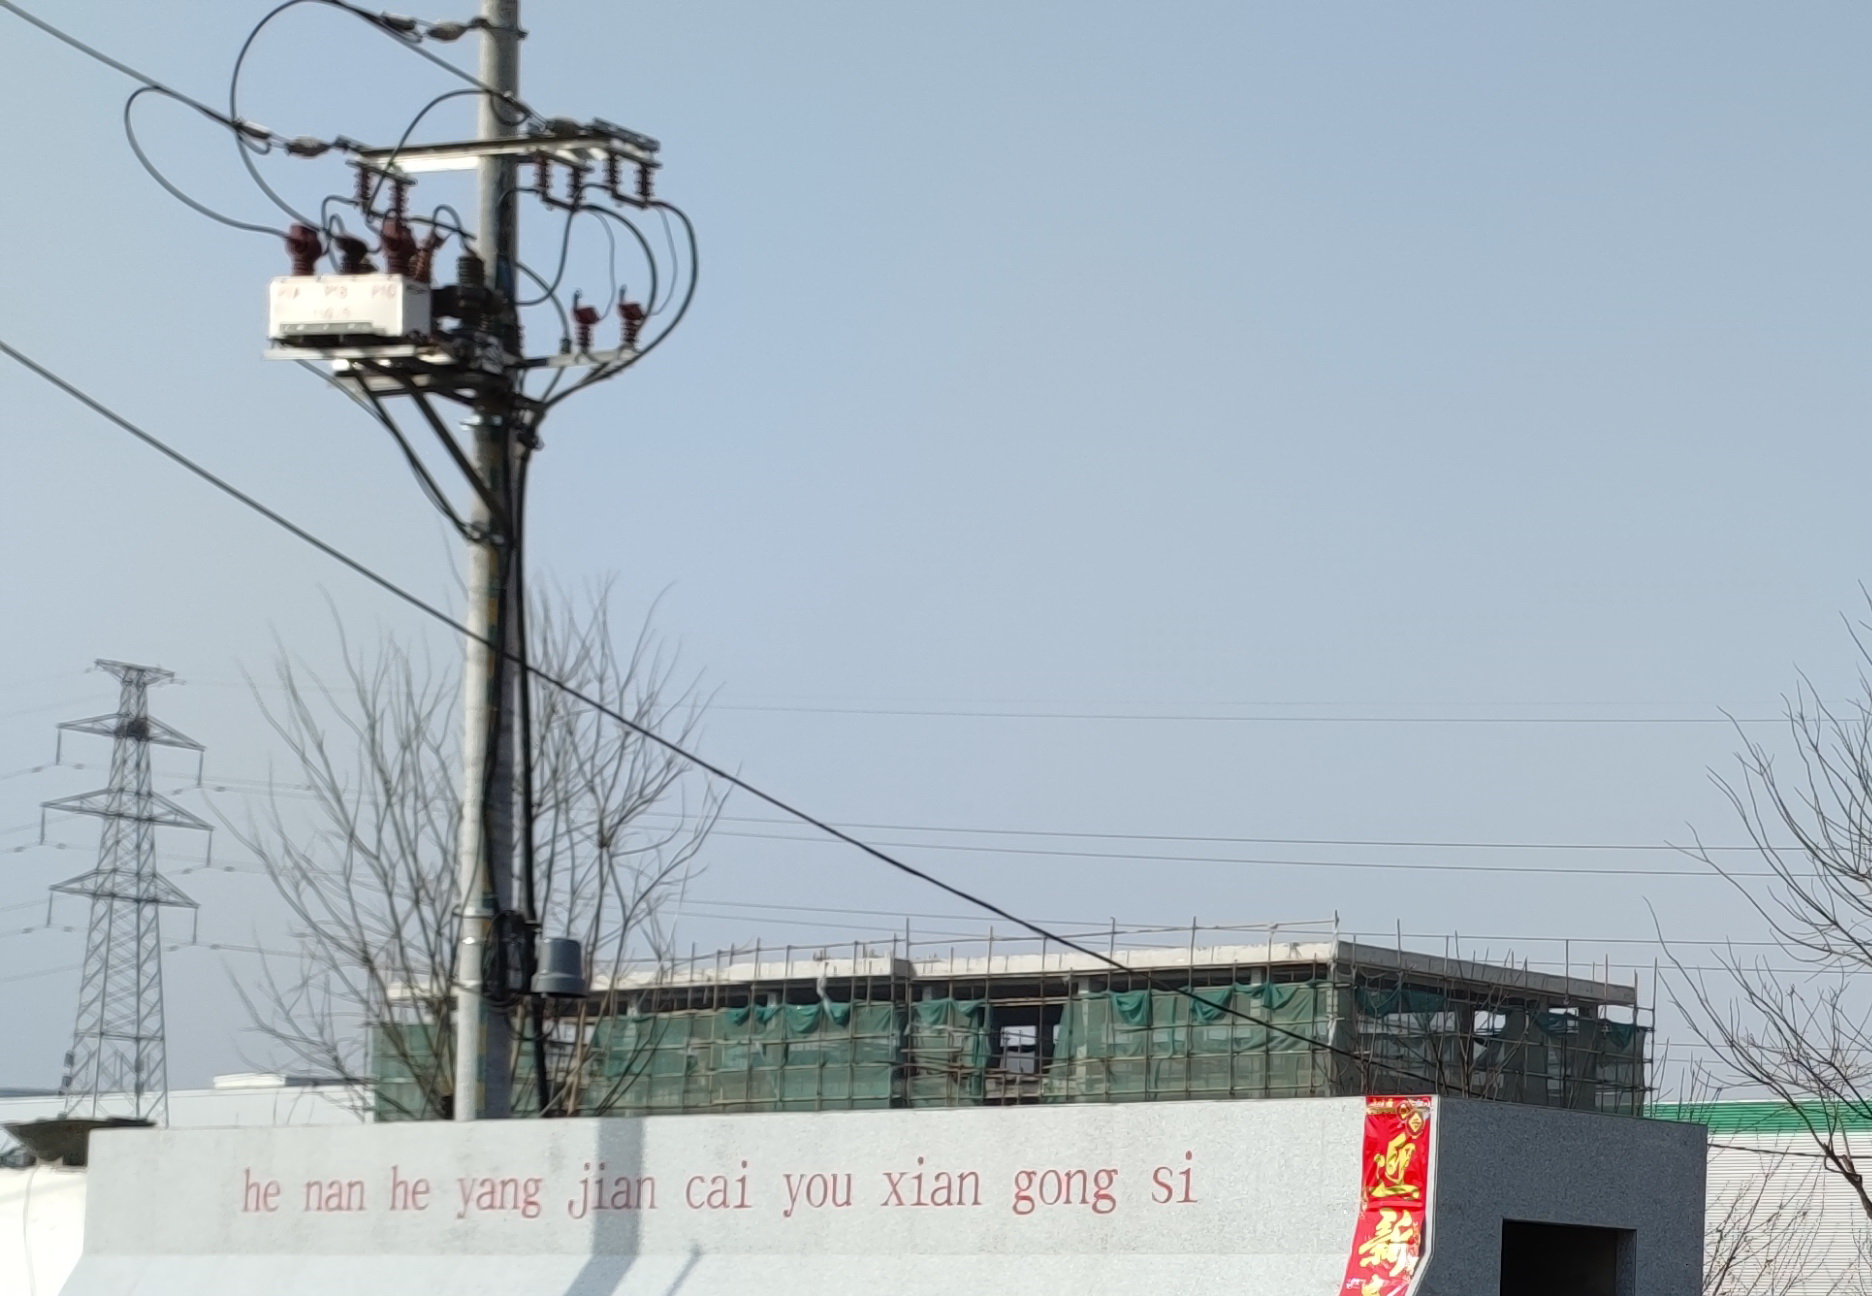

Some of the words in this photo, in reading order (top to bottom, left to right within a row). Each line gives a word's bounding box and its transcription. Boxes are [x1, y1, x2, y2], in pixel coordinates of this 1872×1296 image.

[241, 1167, 280, 1213] he
[303, 1176, 366, 1212] nan
[388, 1164, 430, 1212] he
[455, 1173, 543, 1220] yang
[567, 1161, 659, 1220] jian
[685, 1159, 753, 1210] cai
[782, 1173, 854, 1218] you
[880, 1156, 982, 1208] xian
[1011, 1165, 1120, 1217] gong
[1150, 1149, 1200, 1206] si
